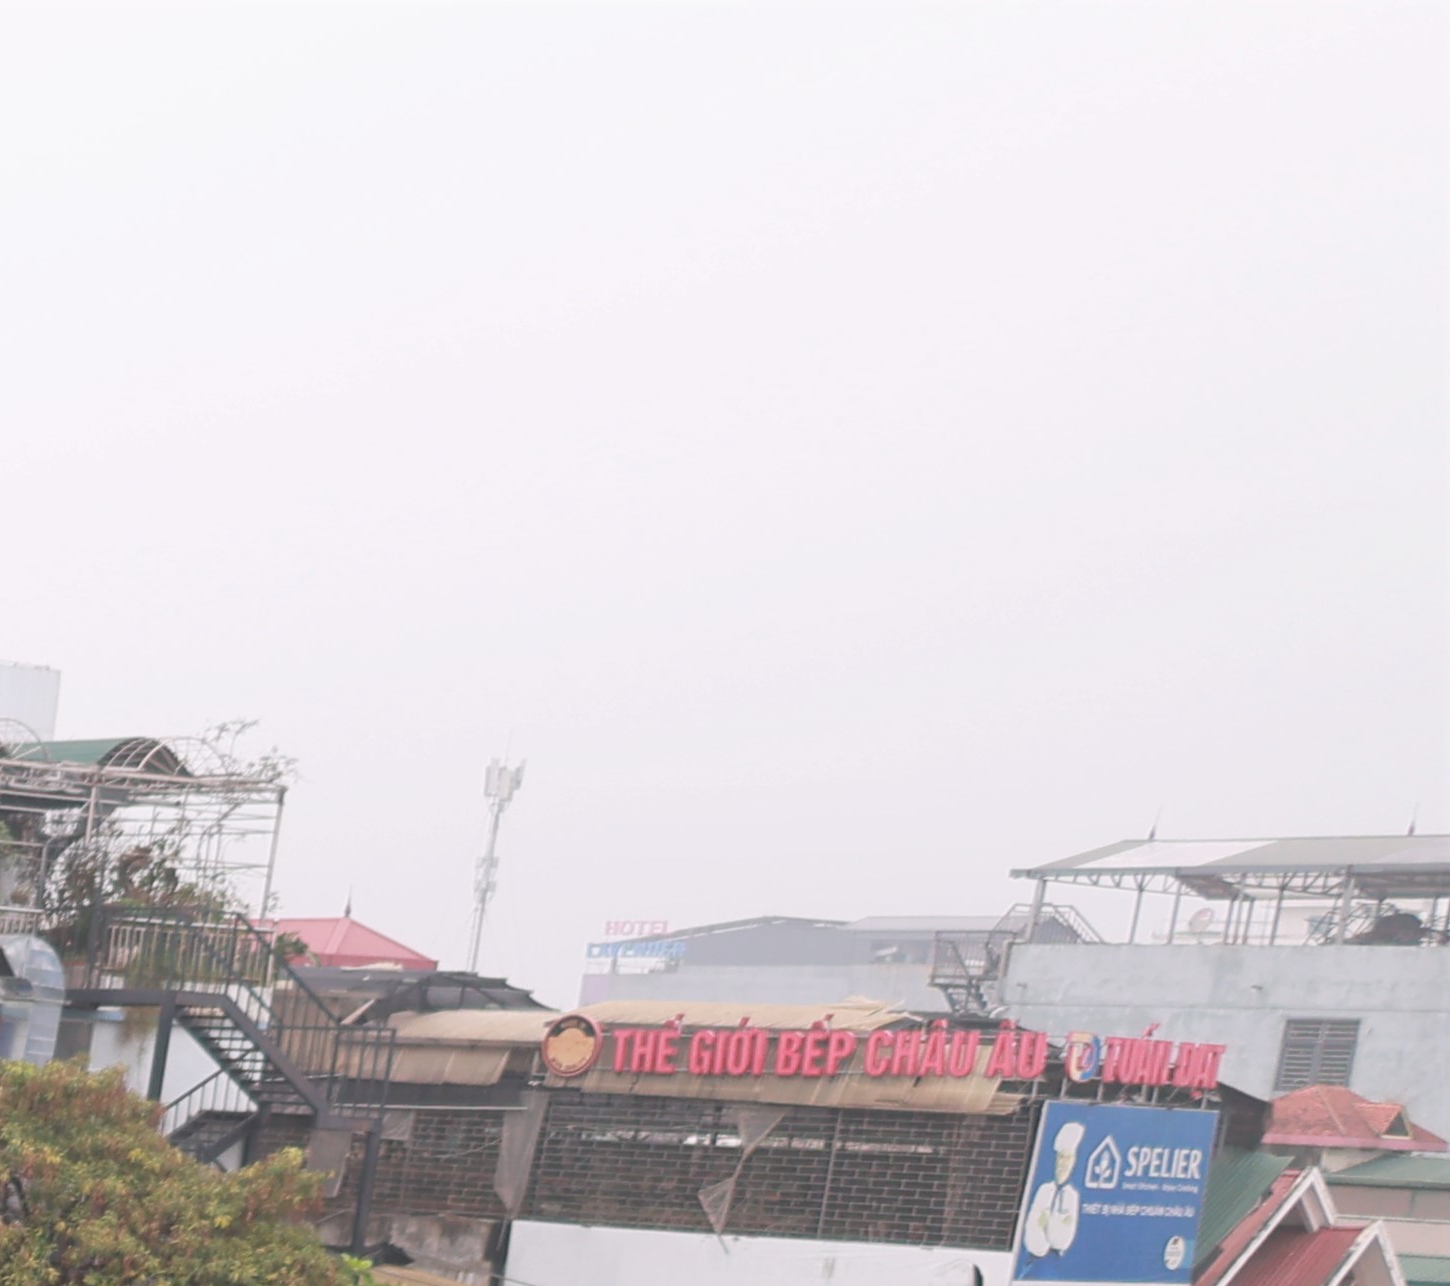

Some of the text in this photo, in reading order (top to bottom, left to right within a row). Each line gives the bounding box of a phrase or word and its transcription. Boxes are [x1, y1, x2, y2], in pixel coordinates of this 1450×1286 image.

[604, 920, 672, 936] HOTEL
[611, 1013, 685, 1074] THẾ
[686, 1016, 769, 1076] GIỚI
[772, 1013, 856, 1077] BẾP
[862, 1018, 982, 1078] CHÂU
[983, 1018, 1049, 1079] ÂU
[1102, 1022, 1173, 1087] TUẤN
[1123, 1145, 1204, 1180] SPELIER
